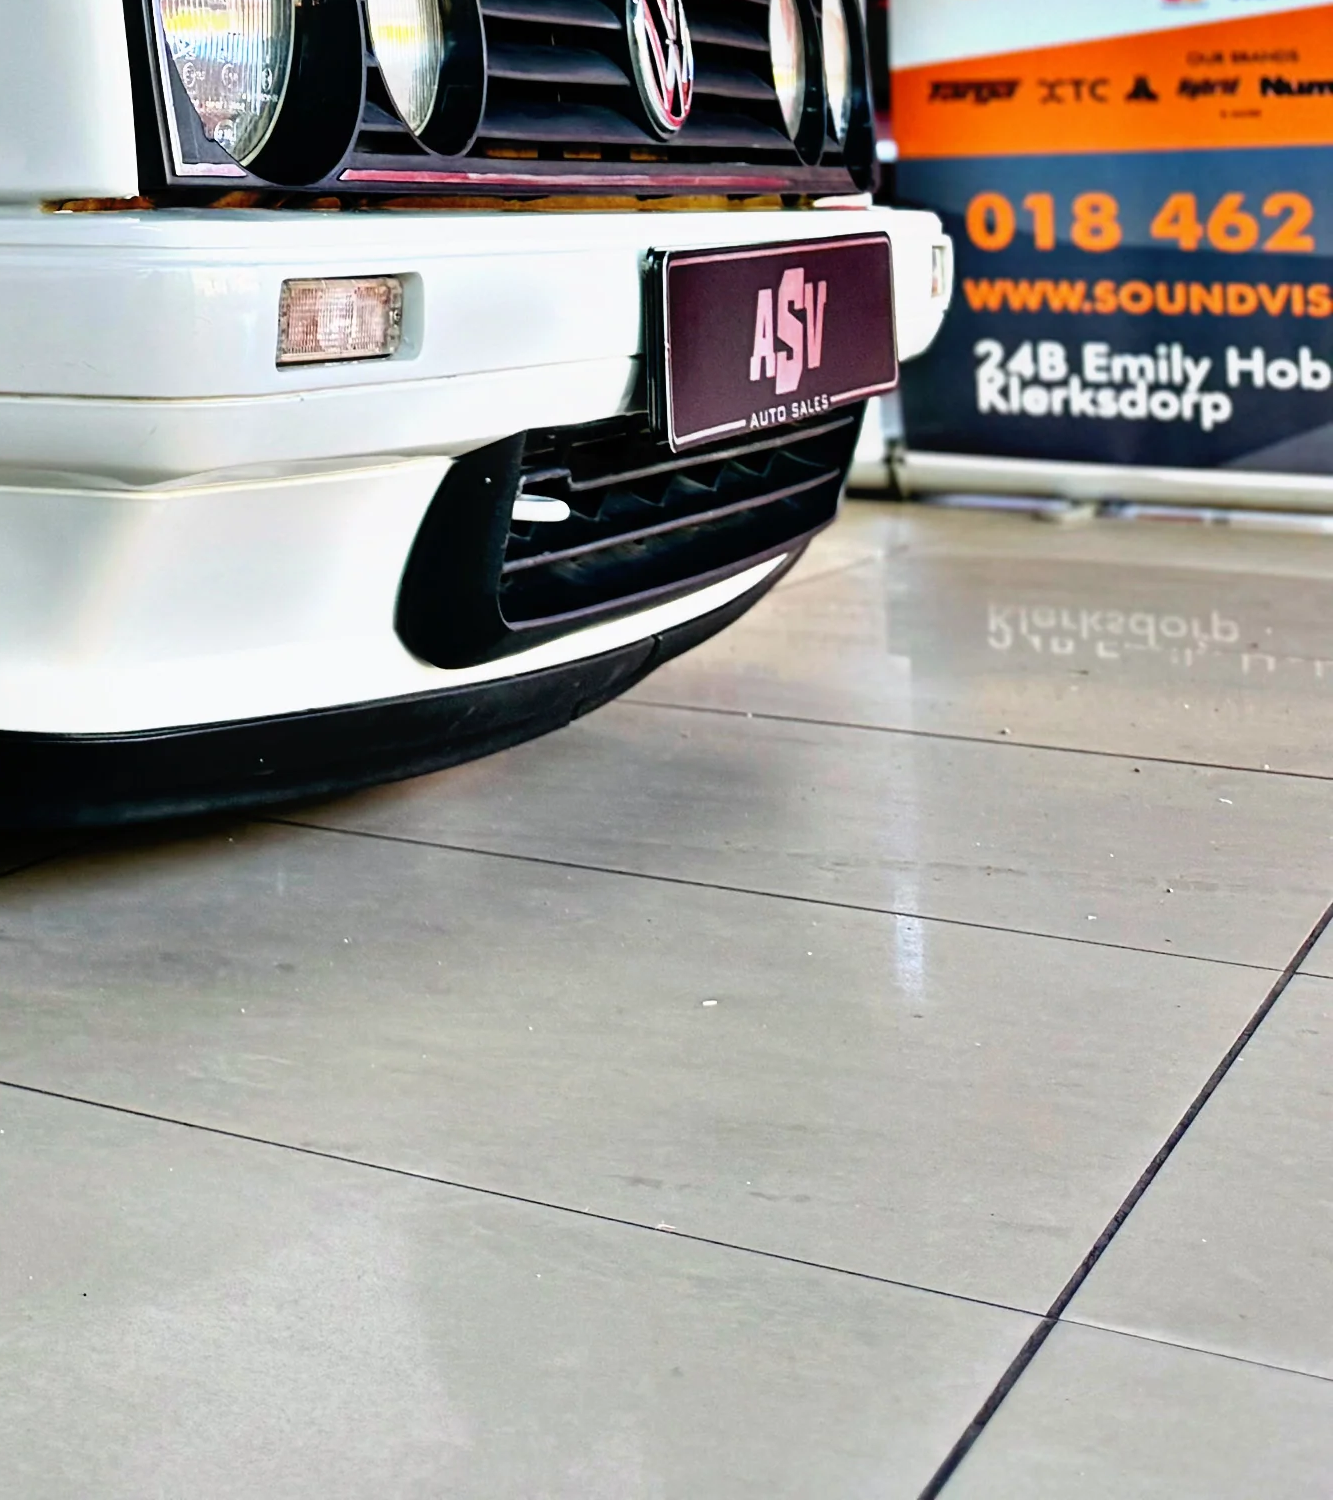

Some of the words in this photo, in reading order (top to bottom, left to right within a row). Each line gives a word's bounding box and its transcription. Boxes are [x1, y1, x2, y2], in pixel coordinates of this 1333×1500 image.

[965, 190, 1123, 253] 018
[1150, 190, 1315, 254] 462
[962, 278, 1333, 318] WWW.SOUNDVIS
[750, 267, 827, 395] ASV
[973, 339, 1069, 382] 24B
[1083, 342, 1212, 394] Emily
[749, 405, 787, 430] AUTO
[791, 394, 830, 418] SALES
